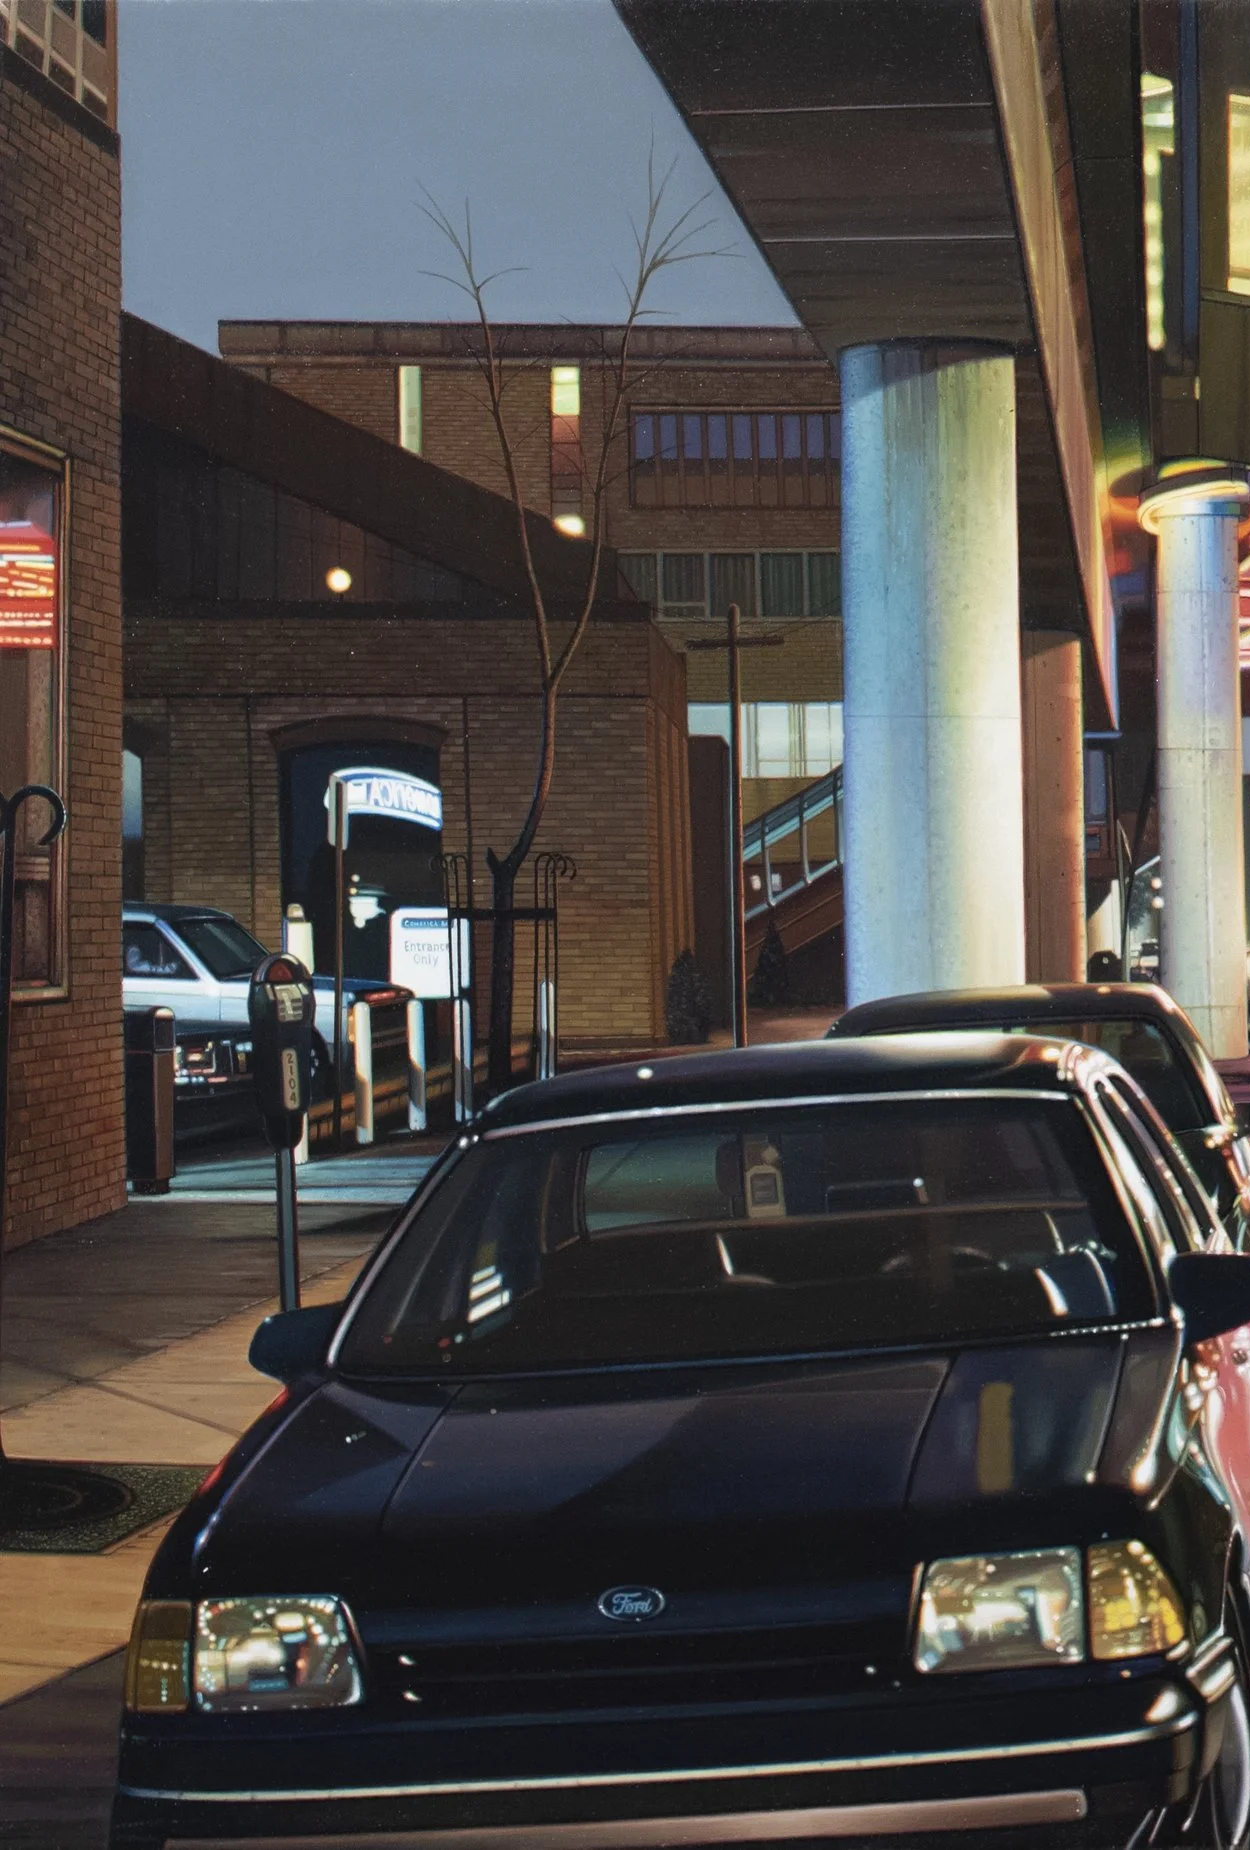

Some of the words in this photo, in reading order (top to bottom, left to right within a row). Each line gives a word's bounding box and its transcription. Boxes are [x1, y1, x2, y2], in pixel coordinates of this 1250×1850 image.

[413, 953, 440, 968] Only
[286, 1053, 298, 1105] 2104
[611, 1592, 653, 1615] Ford
